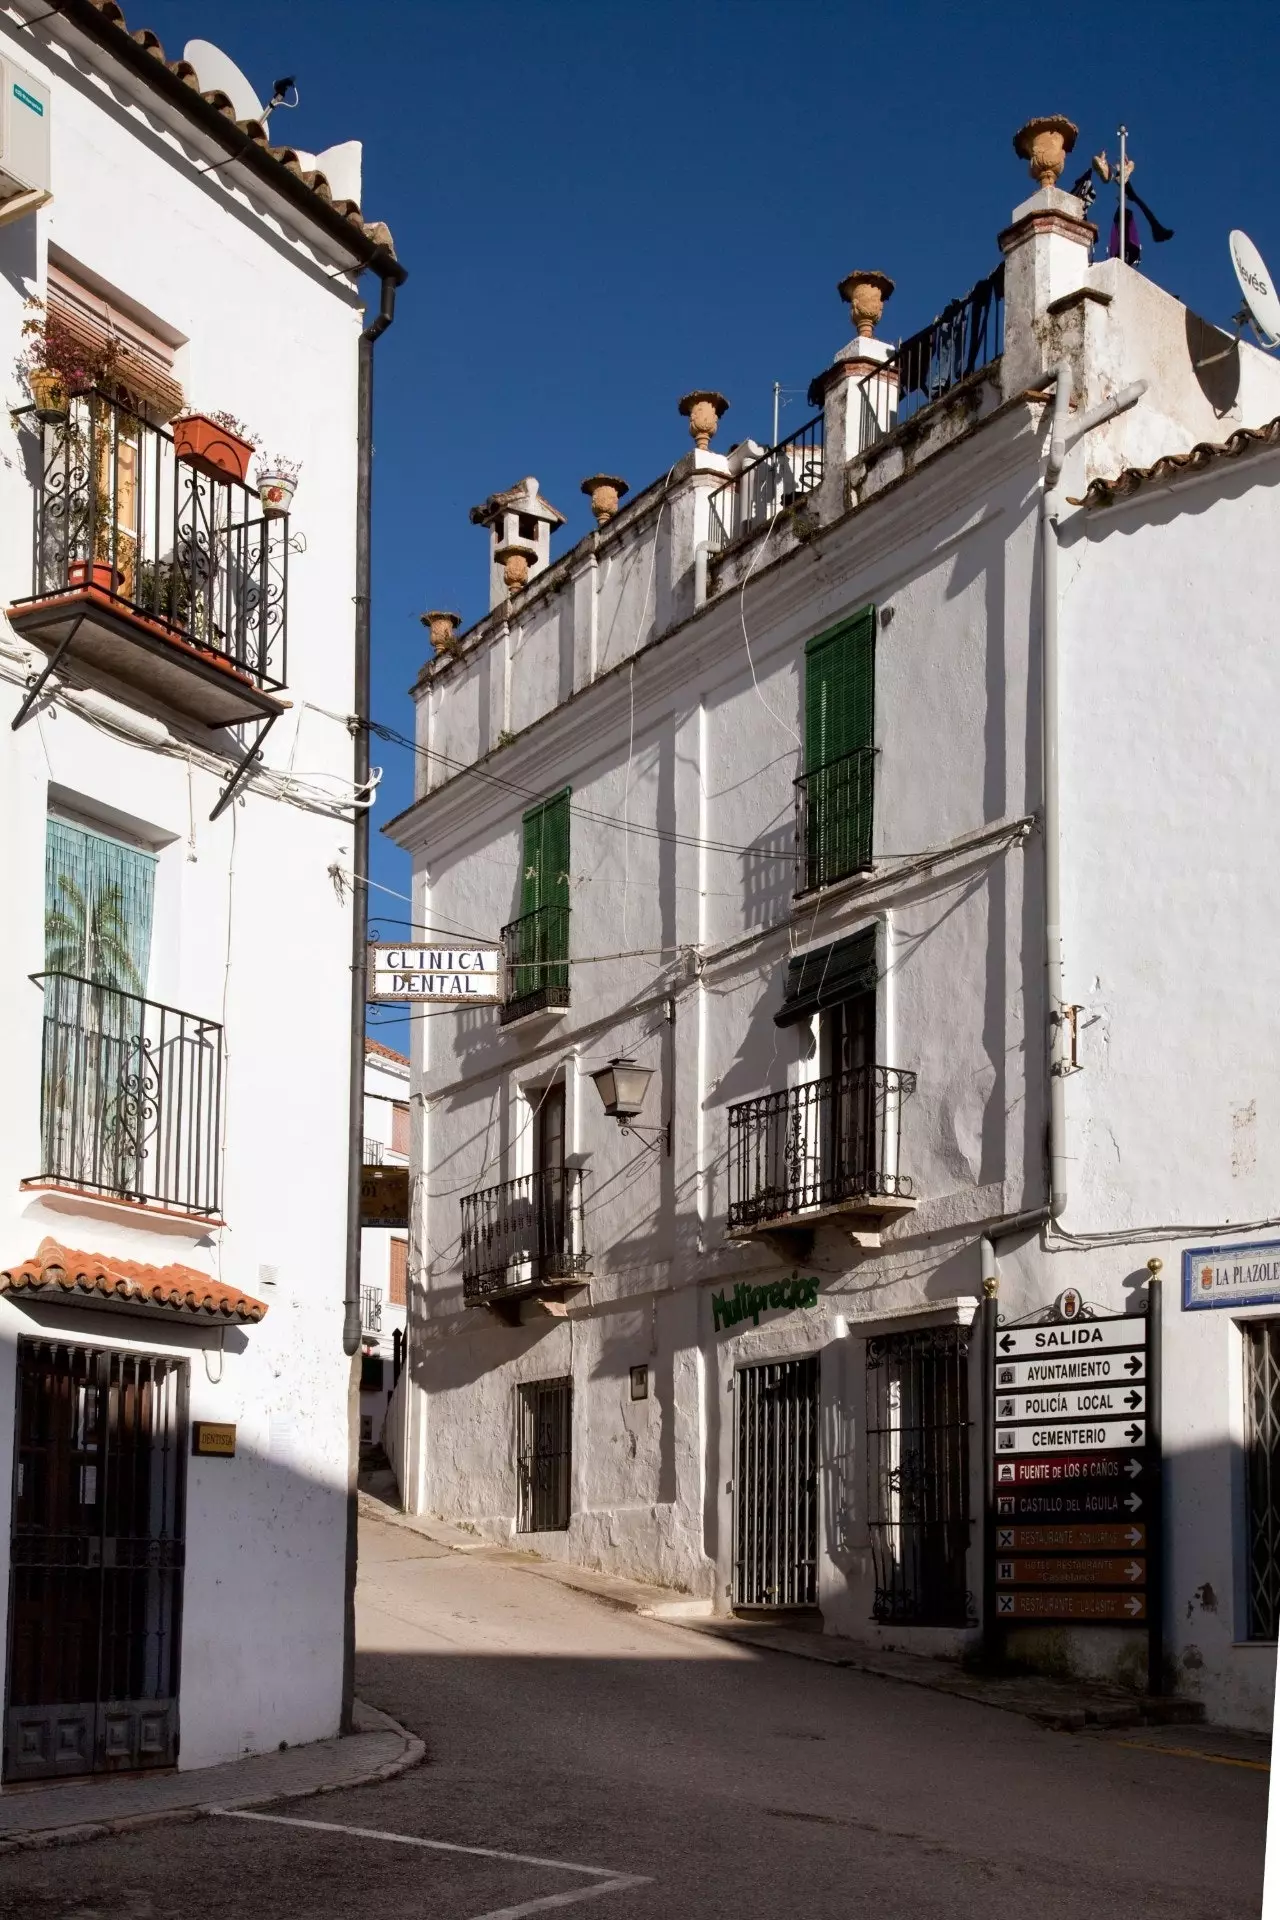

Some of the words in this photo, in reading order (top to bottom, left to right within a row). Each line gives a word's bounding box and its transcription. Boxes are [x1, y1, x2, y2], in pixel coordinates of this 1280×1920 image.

[387, 951, 485, 971] CLINICA
[393, 974, 478, 993] DENTAL
[1216, 1268, 1229, 1286] LA
[1233, 1262, 1280, 1284] PLAZOLE
[711, 1269, 820, 1333] Multiprecios
[1035, 1328, 1103, 1347] SALIDA
[1027, 1360, 1111, 1381] AYUNTAMIENTO
[1025, 1393, 1068, 1413] POLICÍA
[1077, 1394, 1113, 1411] LOCAL
[201, 1432, 233, 1446] DENTISTA
[1032, 1428, 1106, 1446] CEMENTERIO
[1019, 1464, 1050, 1479] FUENTE
[1064, 1462, 1080, 1477] LOS
[1082, 1463, 1088, 1477] 6
[1090, 1458, 1119, 1476] CAÑOS
[1020, 1497, 1063, 1512] CASTILLO
[1066, 1499, 1081, 1511] DEL
[1085, 1493, 1118, 1511] ÁGUILA
[1020, 1531, 1073, 1545] RESTAURANTE
[1024, 1560, 1050, 1570] HOTEL
[1056, 1560, 1113, 1570] RESTAURANTE
[1020, 1597, 1073, 1612] RESTAURANTE
